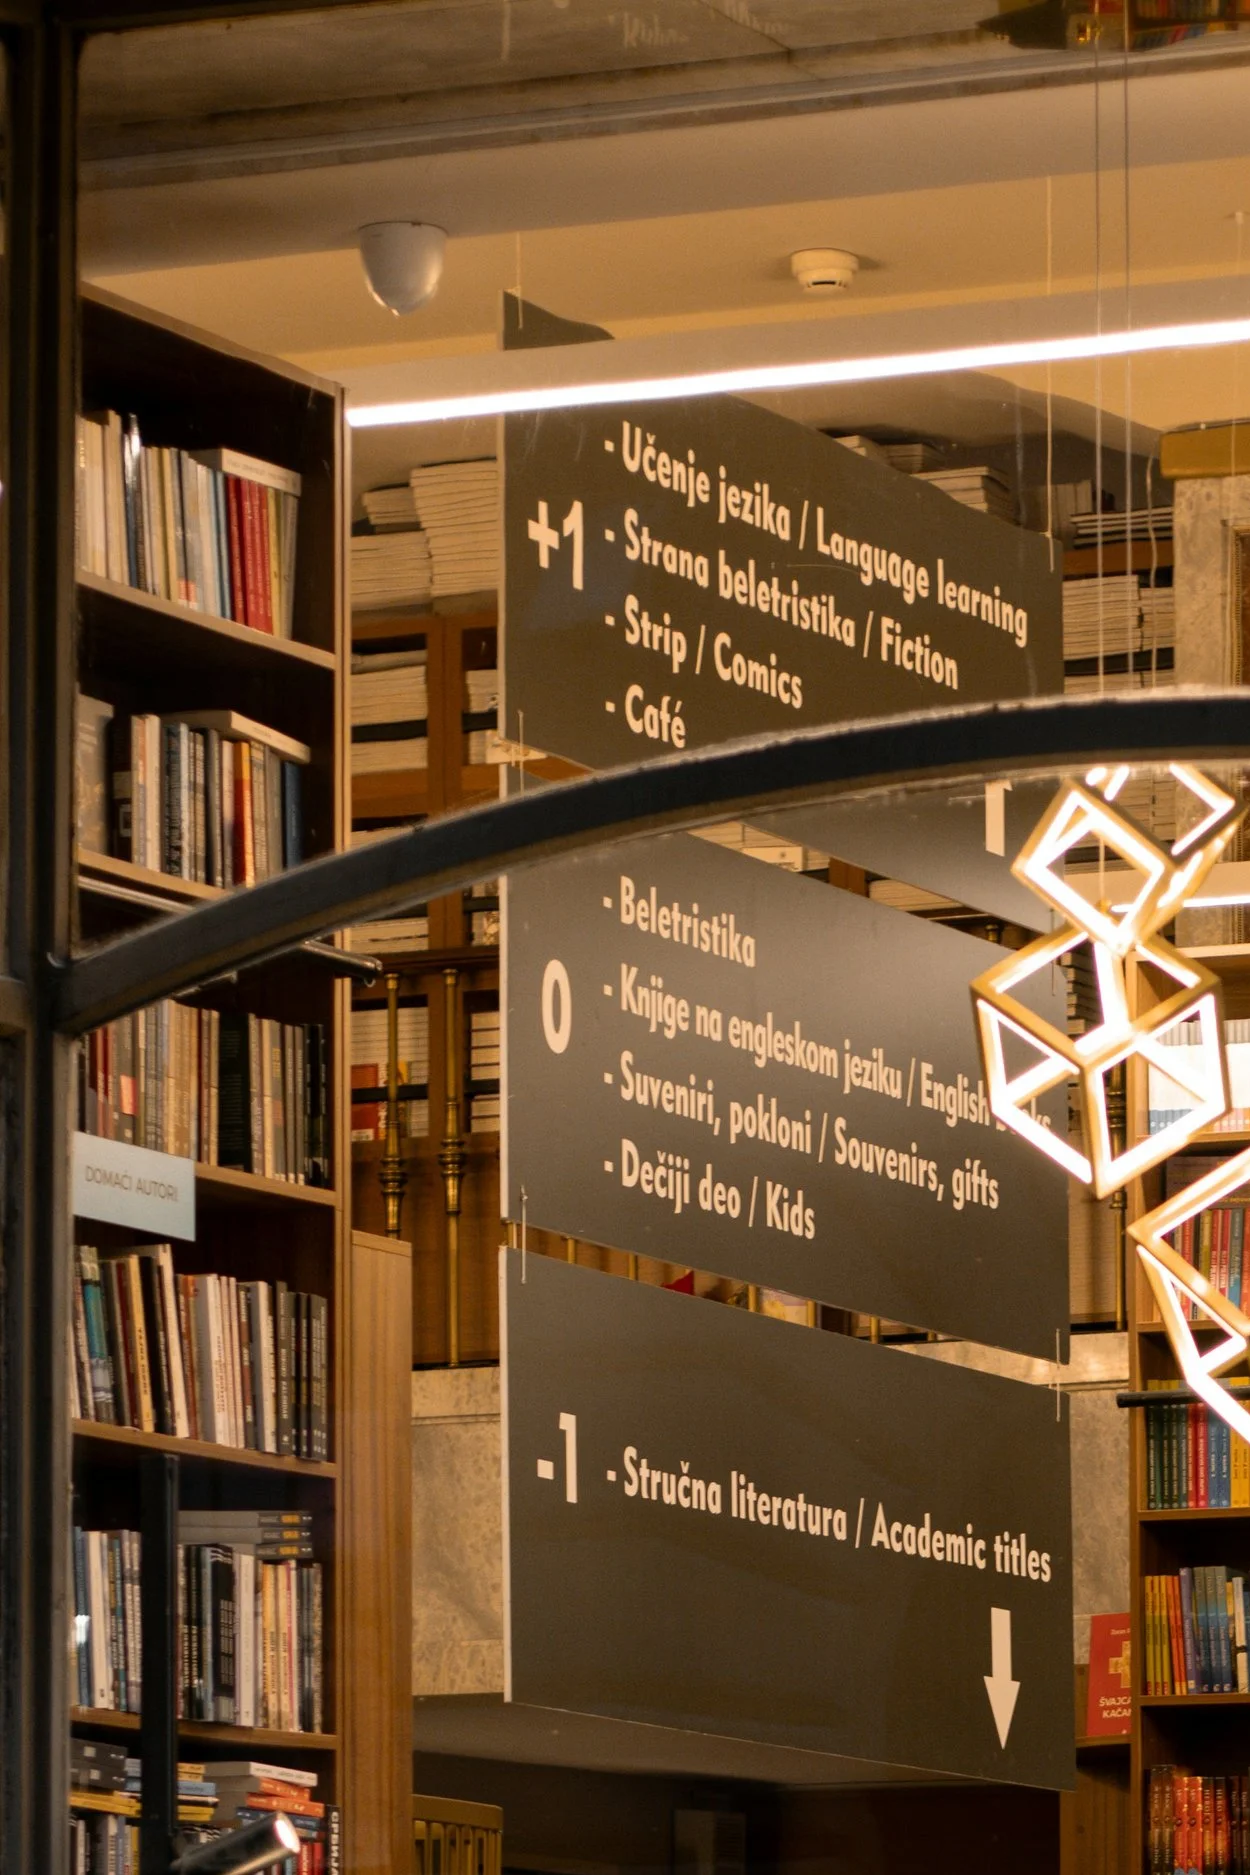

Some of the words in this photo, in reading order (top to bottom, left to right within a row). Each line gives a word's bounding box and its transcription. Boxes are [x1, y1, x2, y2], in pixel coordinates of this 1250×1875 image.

[528, 500, 583, 590] +1
[622, 421, 710, 507] Učenje
[718, 465, 791, 541] jezika
[817, 507, 929, 605] Language
[937, 559, 1028, 648] learning
[624, 508, 709, 588] Strana
[719, 550, 855, 647] beletristika
[881, 616, 958, 690] Fiction
[625, 594, 687, 674] Strip
[714, 632, 803, 709] Comics
[625, 684, 686, 748] Café
[621, 876, 755, 967] Beletristika
[542, 959, 571, 1053] 0
[621, 963, 689, 1039] Knjige
[696, 1006, 721, 1041] na
[729, 1012, 838, 1078] engleskom
[844, 1039, 901, 1099] jeziku
[921, 1062, 990, 1127] English
[621, 1051, 720, 1135] Suveniri,
[730, 1094, 811, 1154] pokloni
[835, 1117, 944, 1201] Souvenirs,
[952, 1158, 999, 1210] gifts
[85, 1166, 132, 1190] DOMAĆI
[136, 1180, 178, 1201] AUTORI
[622, 1139, 690, 1213] Dečiji
[699, 1164, 741, 1218] deo
[766, 1181, 815, 1239] Kids
[537, 1412, 577, 1503] -1
[624, 1446, 721, 1514] Stručna
[731, 1471, 847, 1540] literatura
[871, 1502, 986, 1569] Academic
[994, 1531, 1051, 1582] titles
